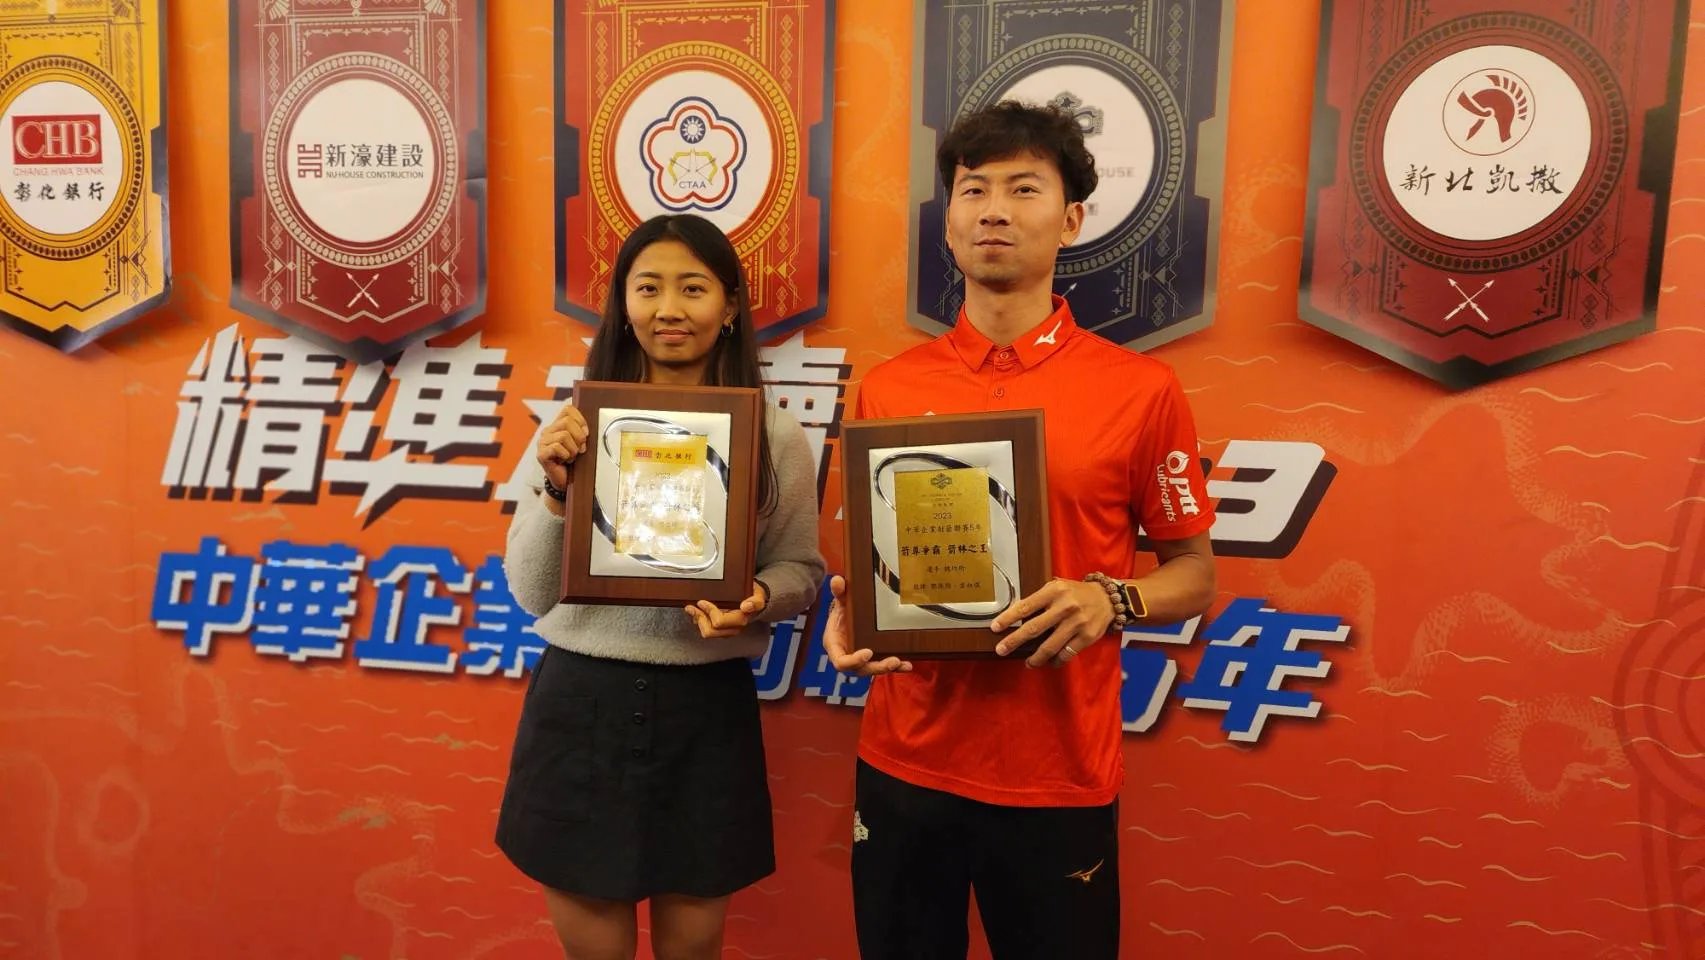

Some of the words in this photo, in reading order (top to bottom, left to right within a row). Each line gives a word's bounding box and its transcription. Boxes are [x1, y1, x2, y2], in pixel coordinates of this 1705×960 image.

[14, 119, 99, 159] CHB
[325, 143, 425, 169] 新濠建設
[13, 167, 48, 177] CHANG
[50, 168, 74, 176] HWA
[75, 167, 105, 176] BANK
[365, 171, 425, 179] CONSTRUCTION
[1398, 163, 1565, 196] 新北凱撒
[13, 181, 106, 203] 彰化銀行
[678, 181, 708, 190] CTAA
[1168, 477, 1201, 516] ptt
[933, 512, 953, 520] 2023
